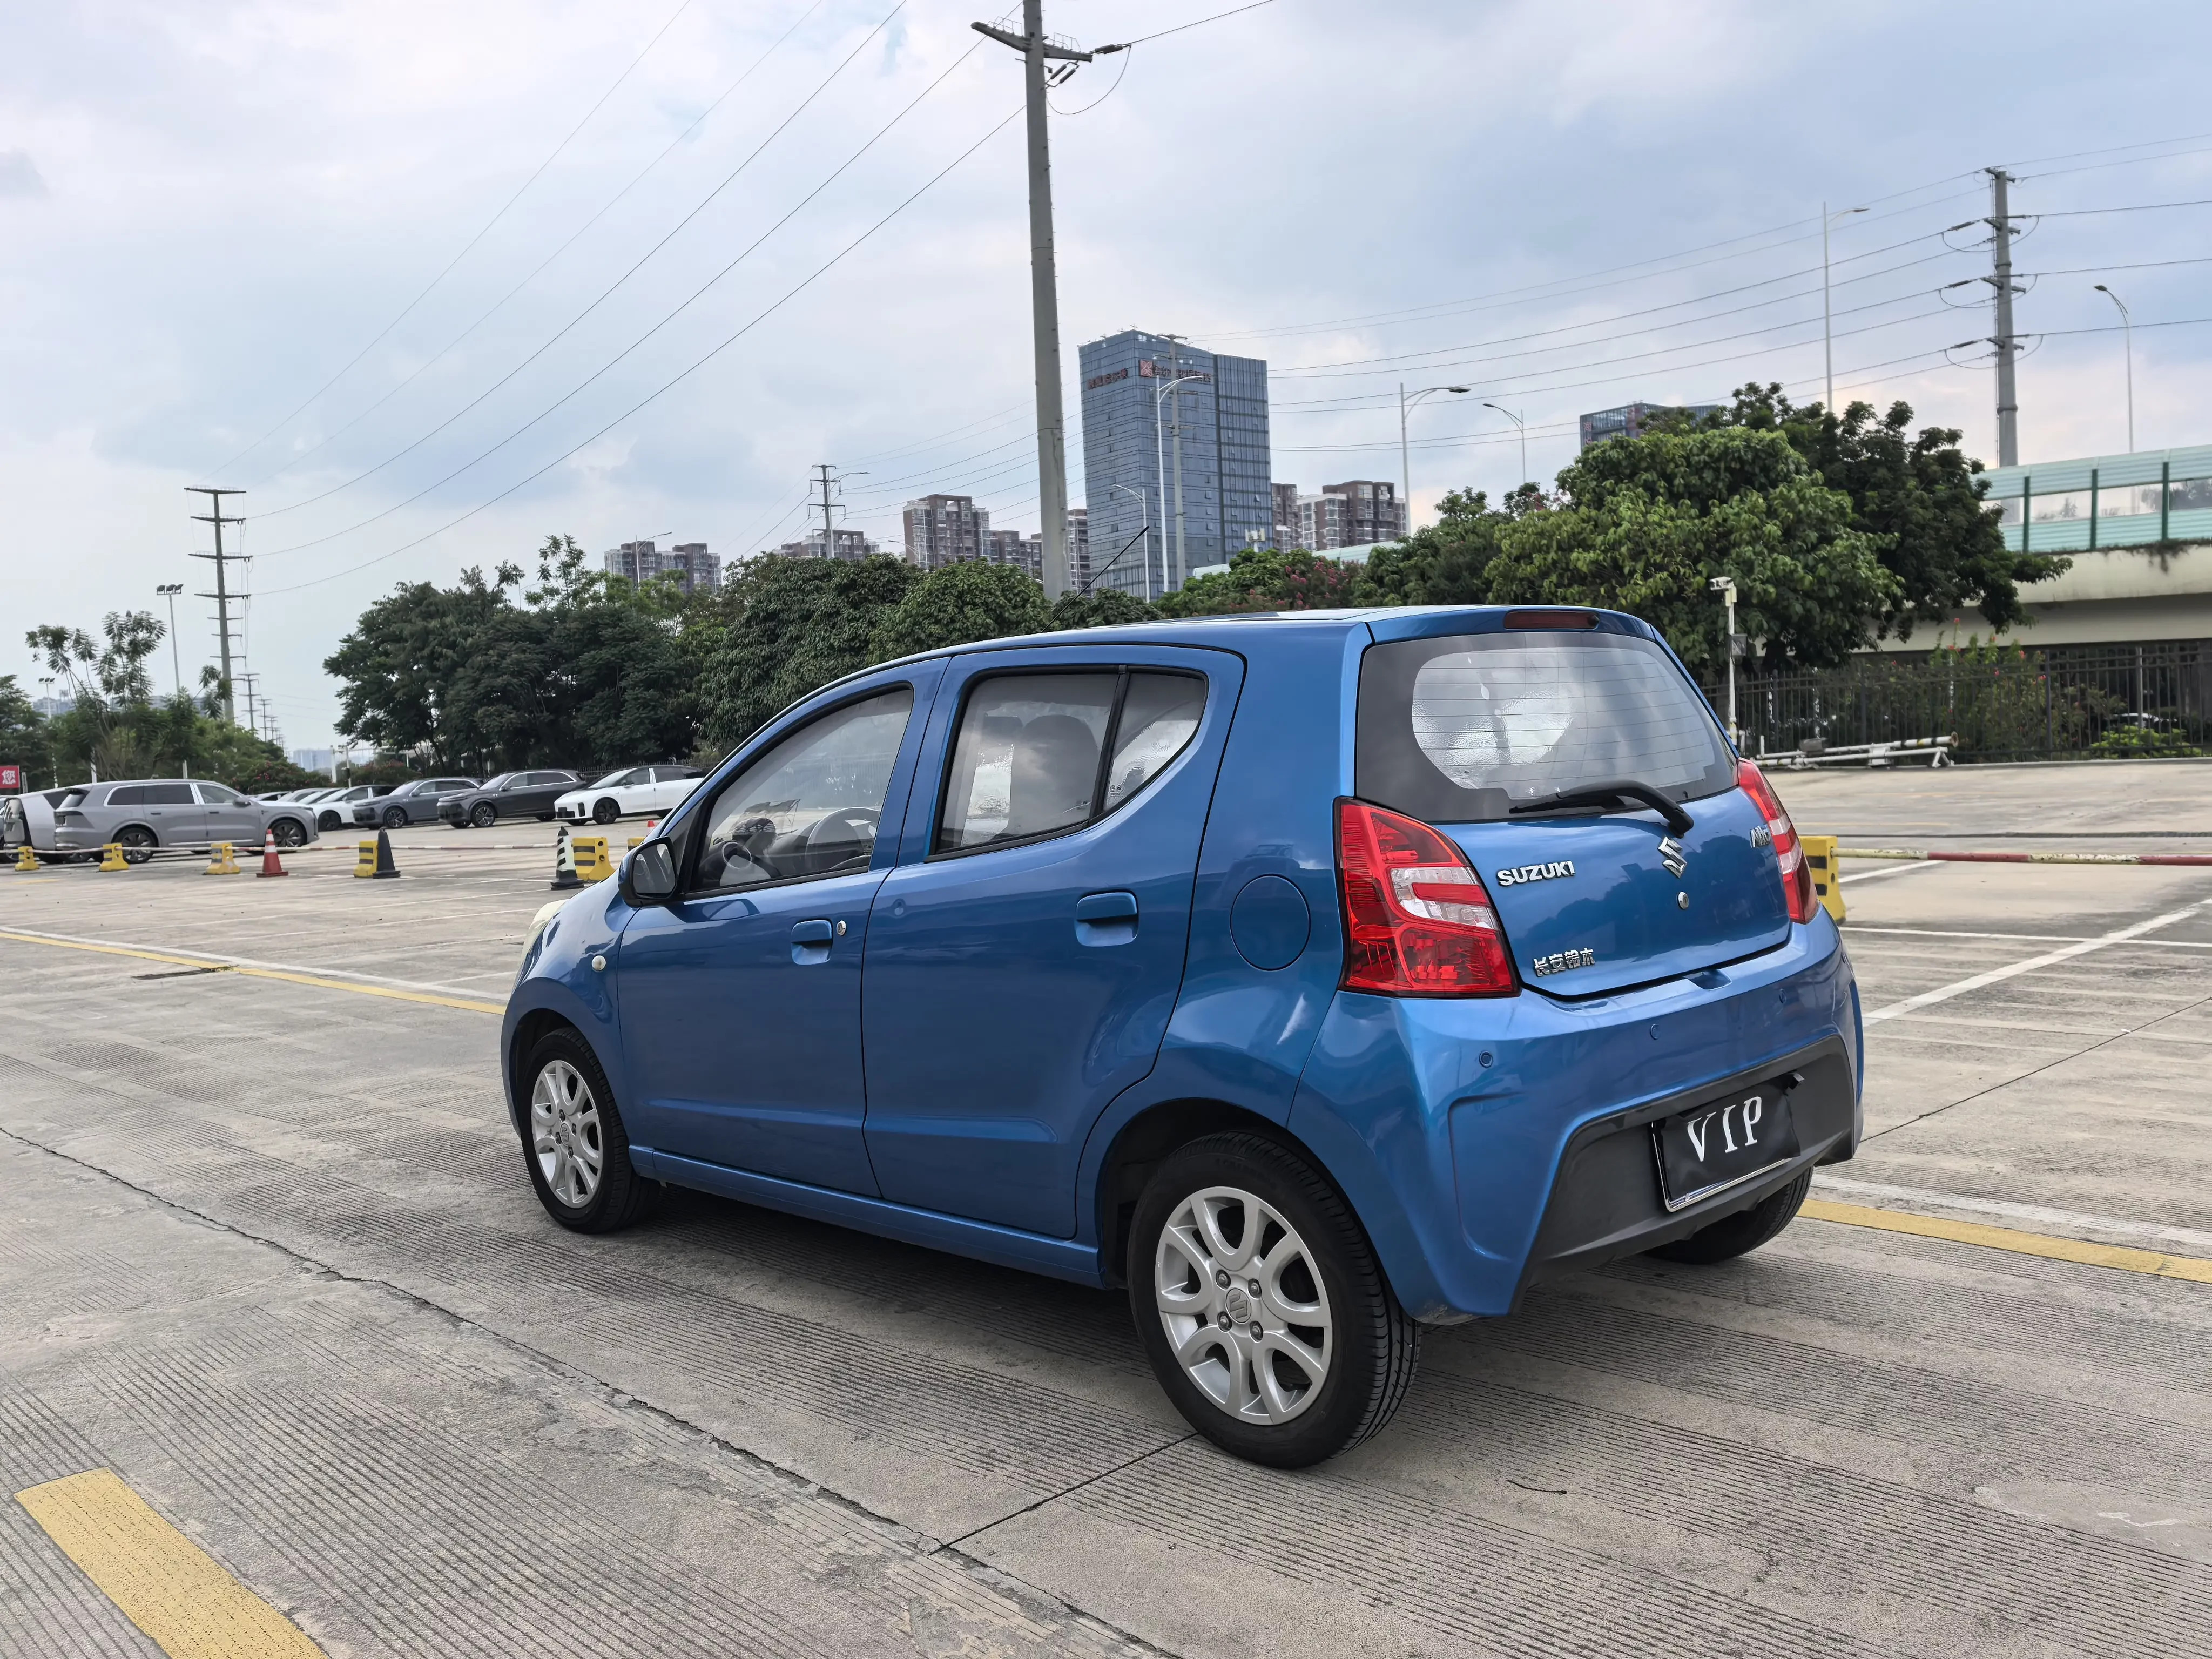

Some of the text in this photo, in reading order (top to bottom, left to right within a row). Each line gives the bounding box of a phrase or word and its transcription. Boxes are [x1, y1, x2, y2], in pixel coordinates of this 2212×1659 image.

[1496, 860, 1575, 886] SUZUKI
[1533, 947, 1595, 977] 长安铃木
[1687, 1096, 1762, 1162] VIP
